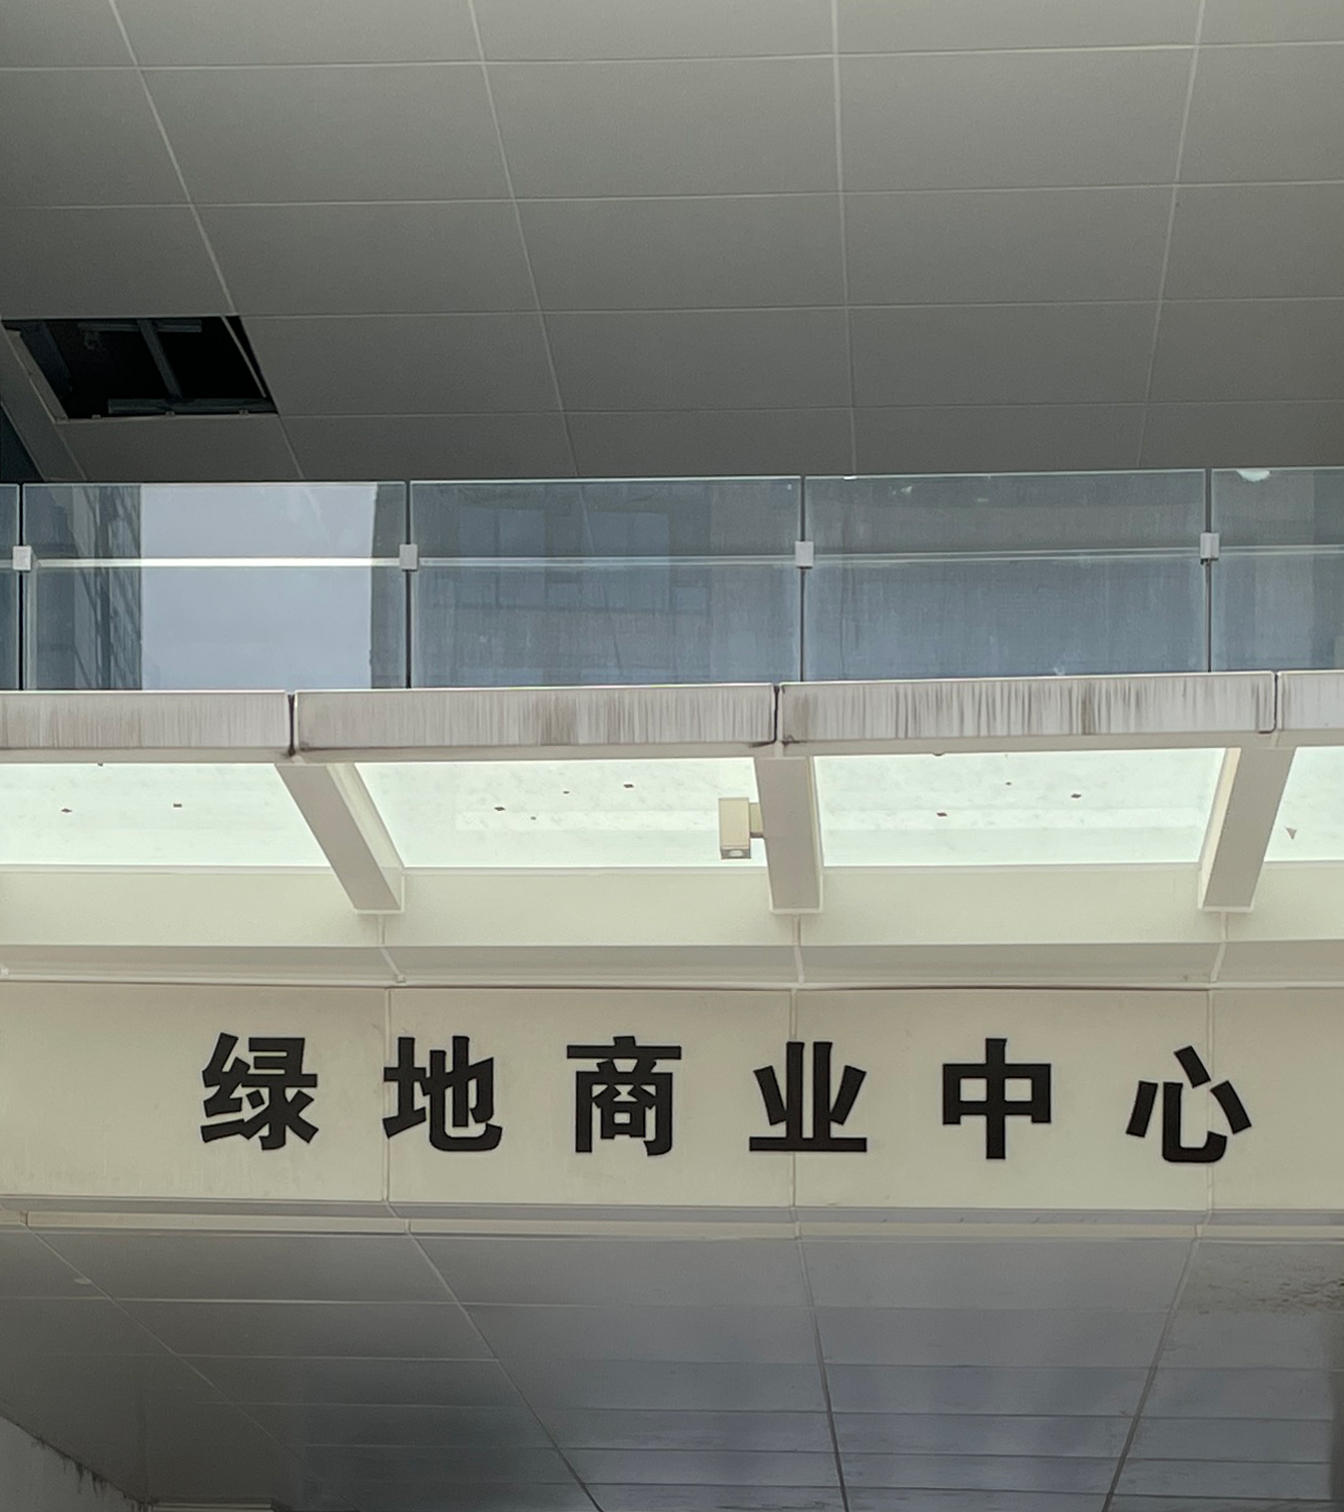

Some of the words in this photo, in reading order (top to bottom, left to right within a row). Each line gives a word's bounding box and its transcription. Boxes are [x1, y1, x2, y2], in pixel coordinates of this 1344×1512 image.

[199, 1031, 1253, 1165] 绿地商业中心
